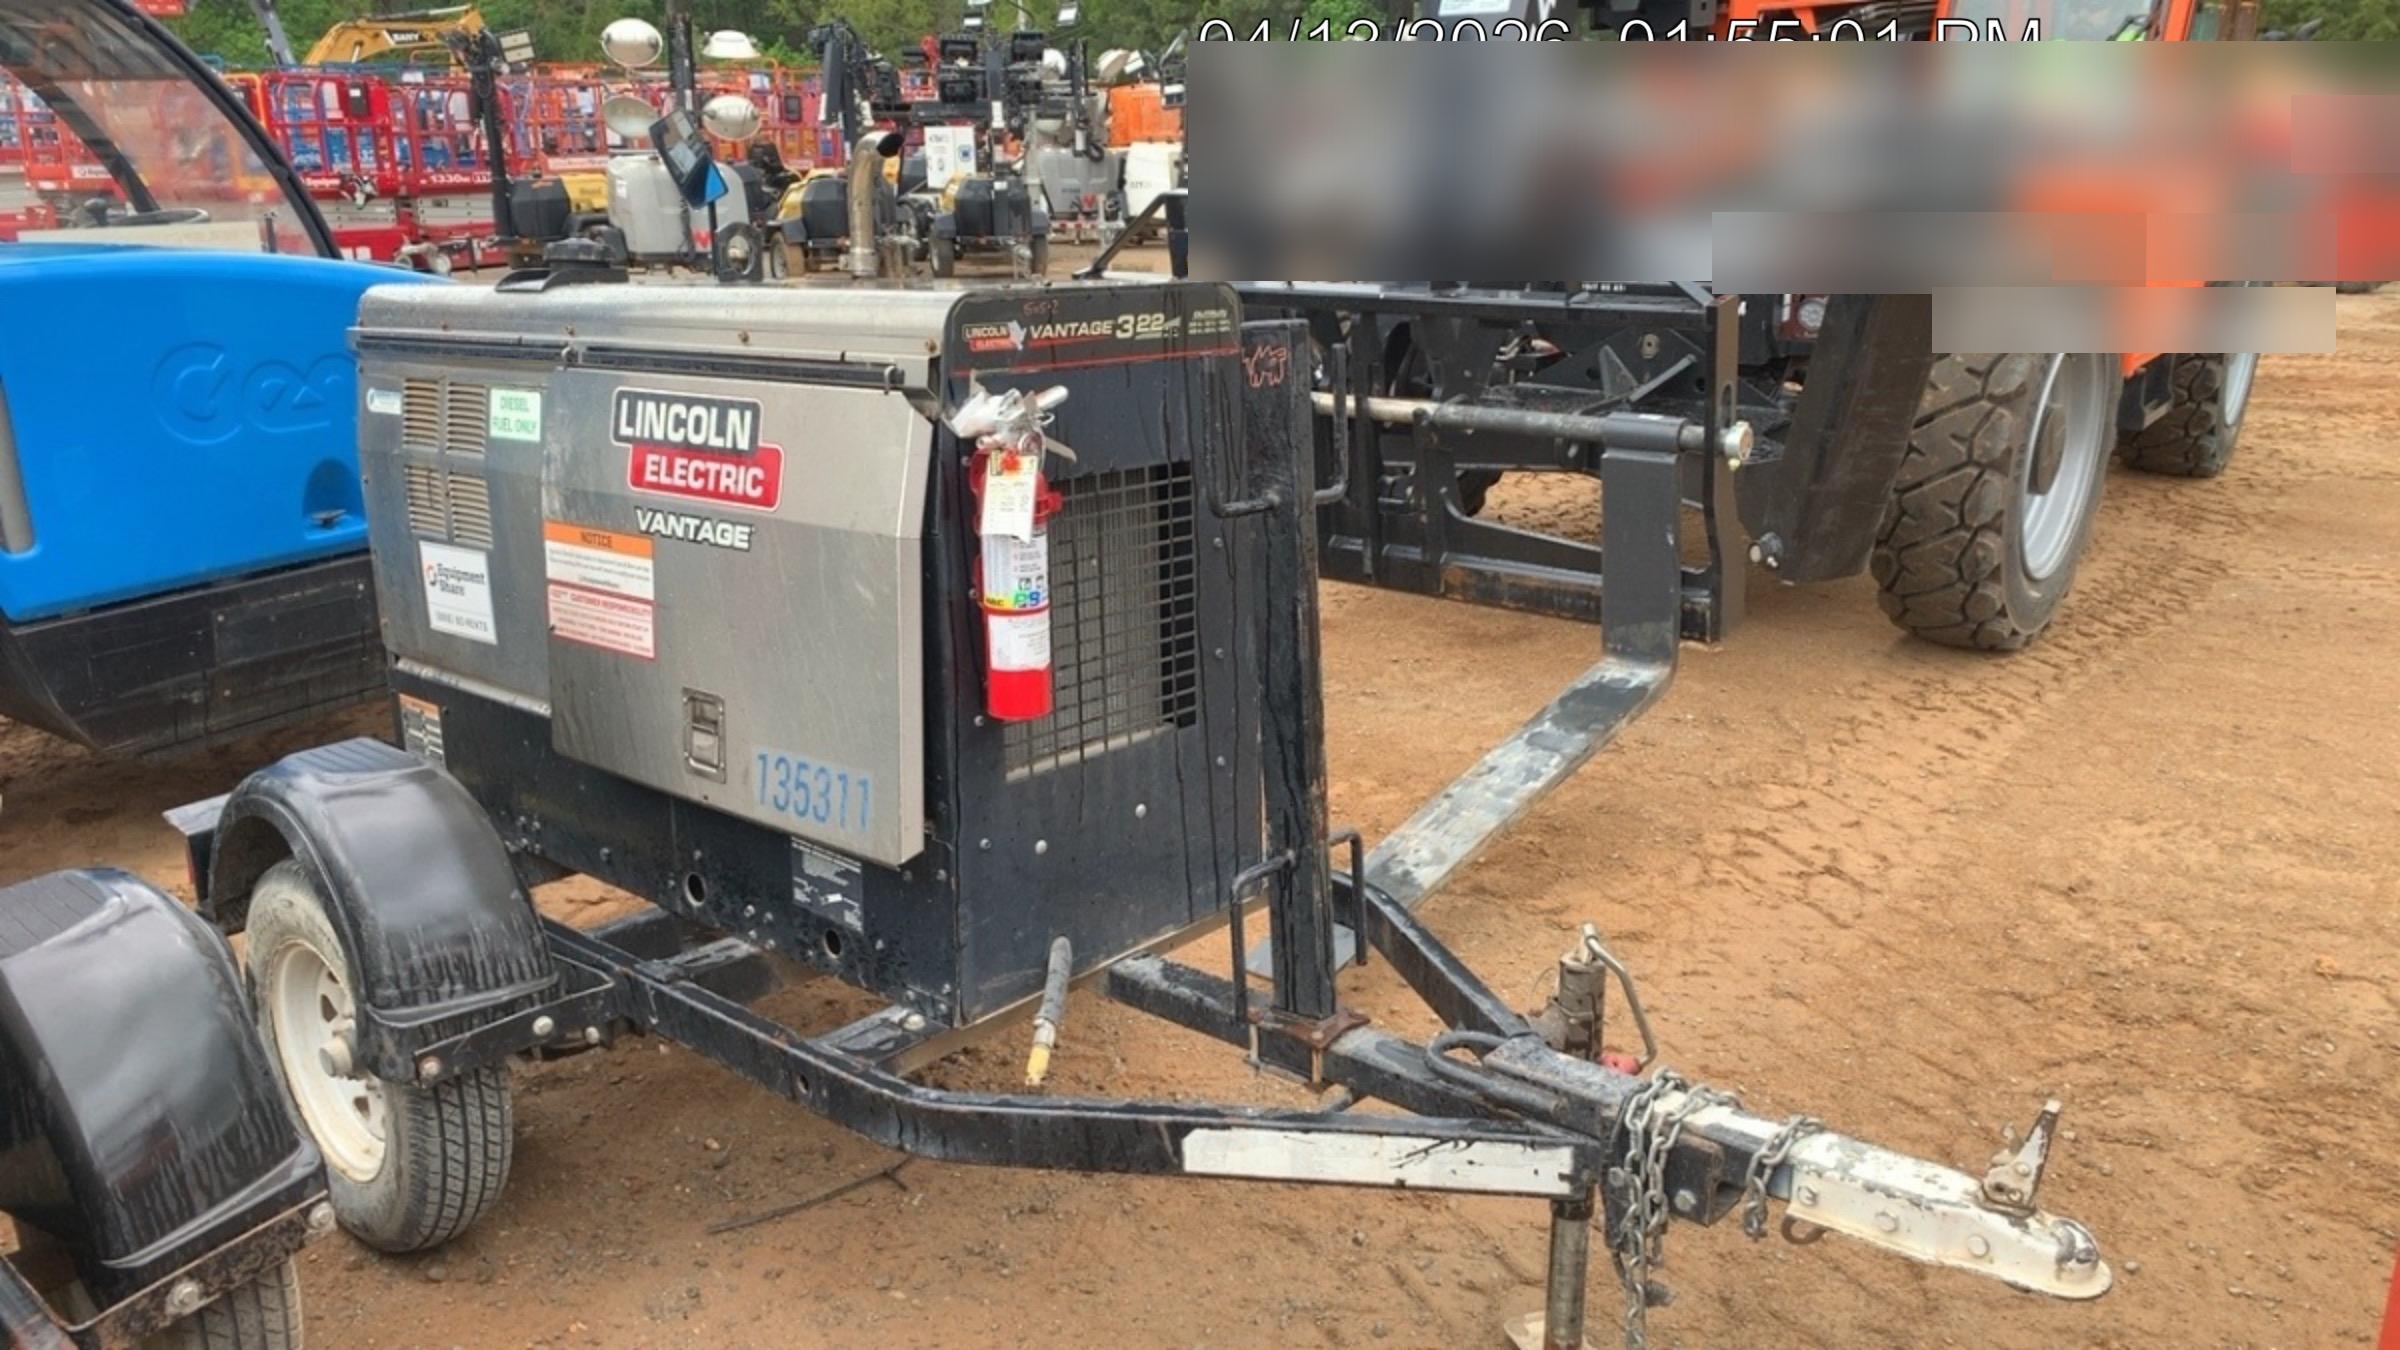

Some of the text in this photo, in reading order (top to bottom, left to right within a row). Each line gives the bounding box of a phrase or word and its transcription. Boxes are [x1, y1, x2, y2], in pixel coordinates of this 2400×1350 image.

[1029, 319, 1113, 339] VANTAGE
[1115, 313, 1166, 339] 322
[618, 397, 752, 451] LINCOLN
[643, 453, 766, 498] ELECTRIC
[580, 531, 613, 549] NOTICE
[635, 507, 752, 551] VANTAGE
[757, 752, 871, 831] 135311
